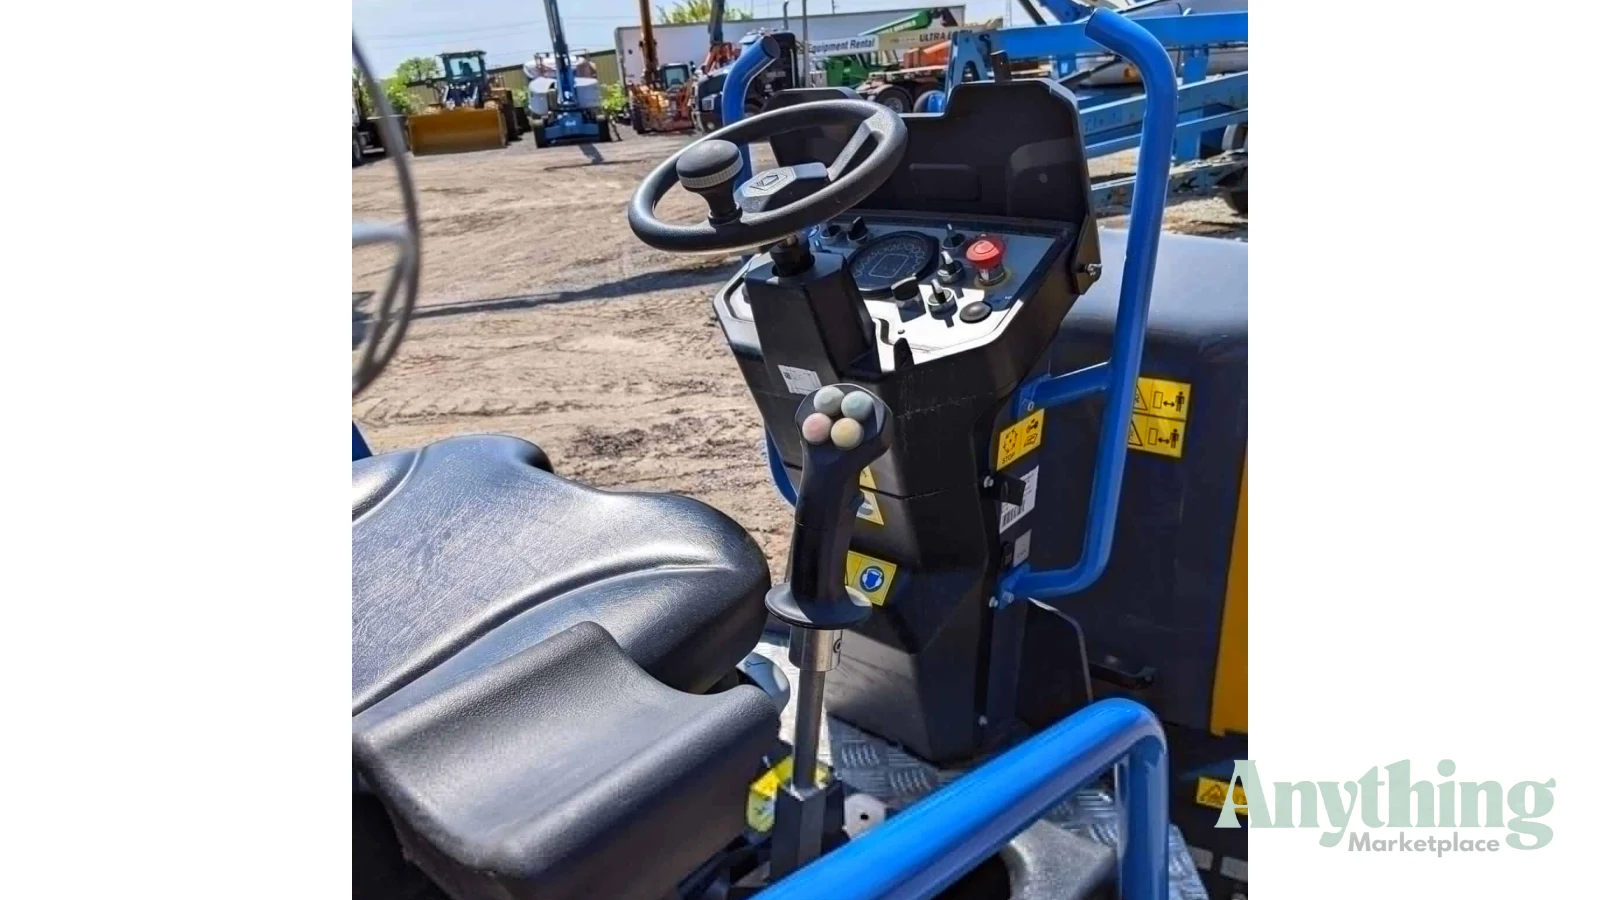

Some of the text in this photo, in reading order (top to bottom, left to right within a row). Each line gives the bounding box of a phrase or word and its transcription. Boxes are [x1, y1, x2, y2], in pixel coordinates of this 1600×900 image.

[919, 32, 946, 42] ULTRA
[850, 38, 876, 49] Rental
[1002, 452, 1015, 465] STOP
